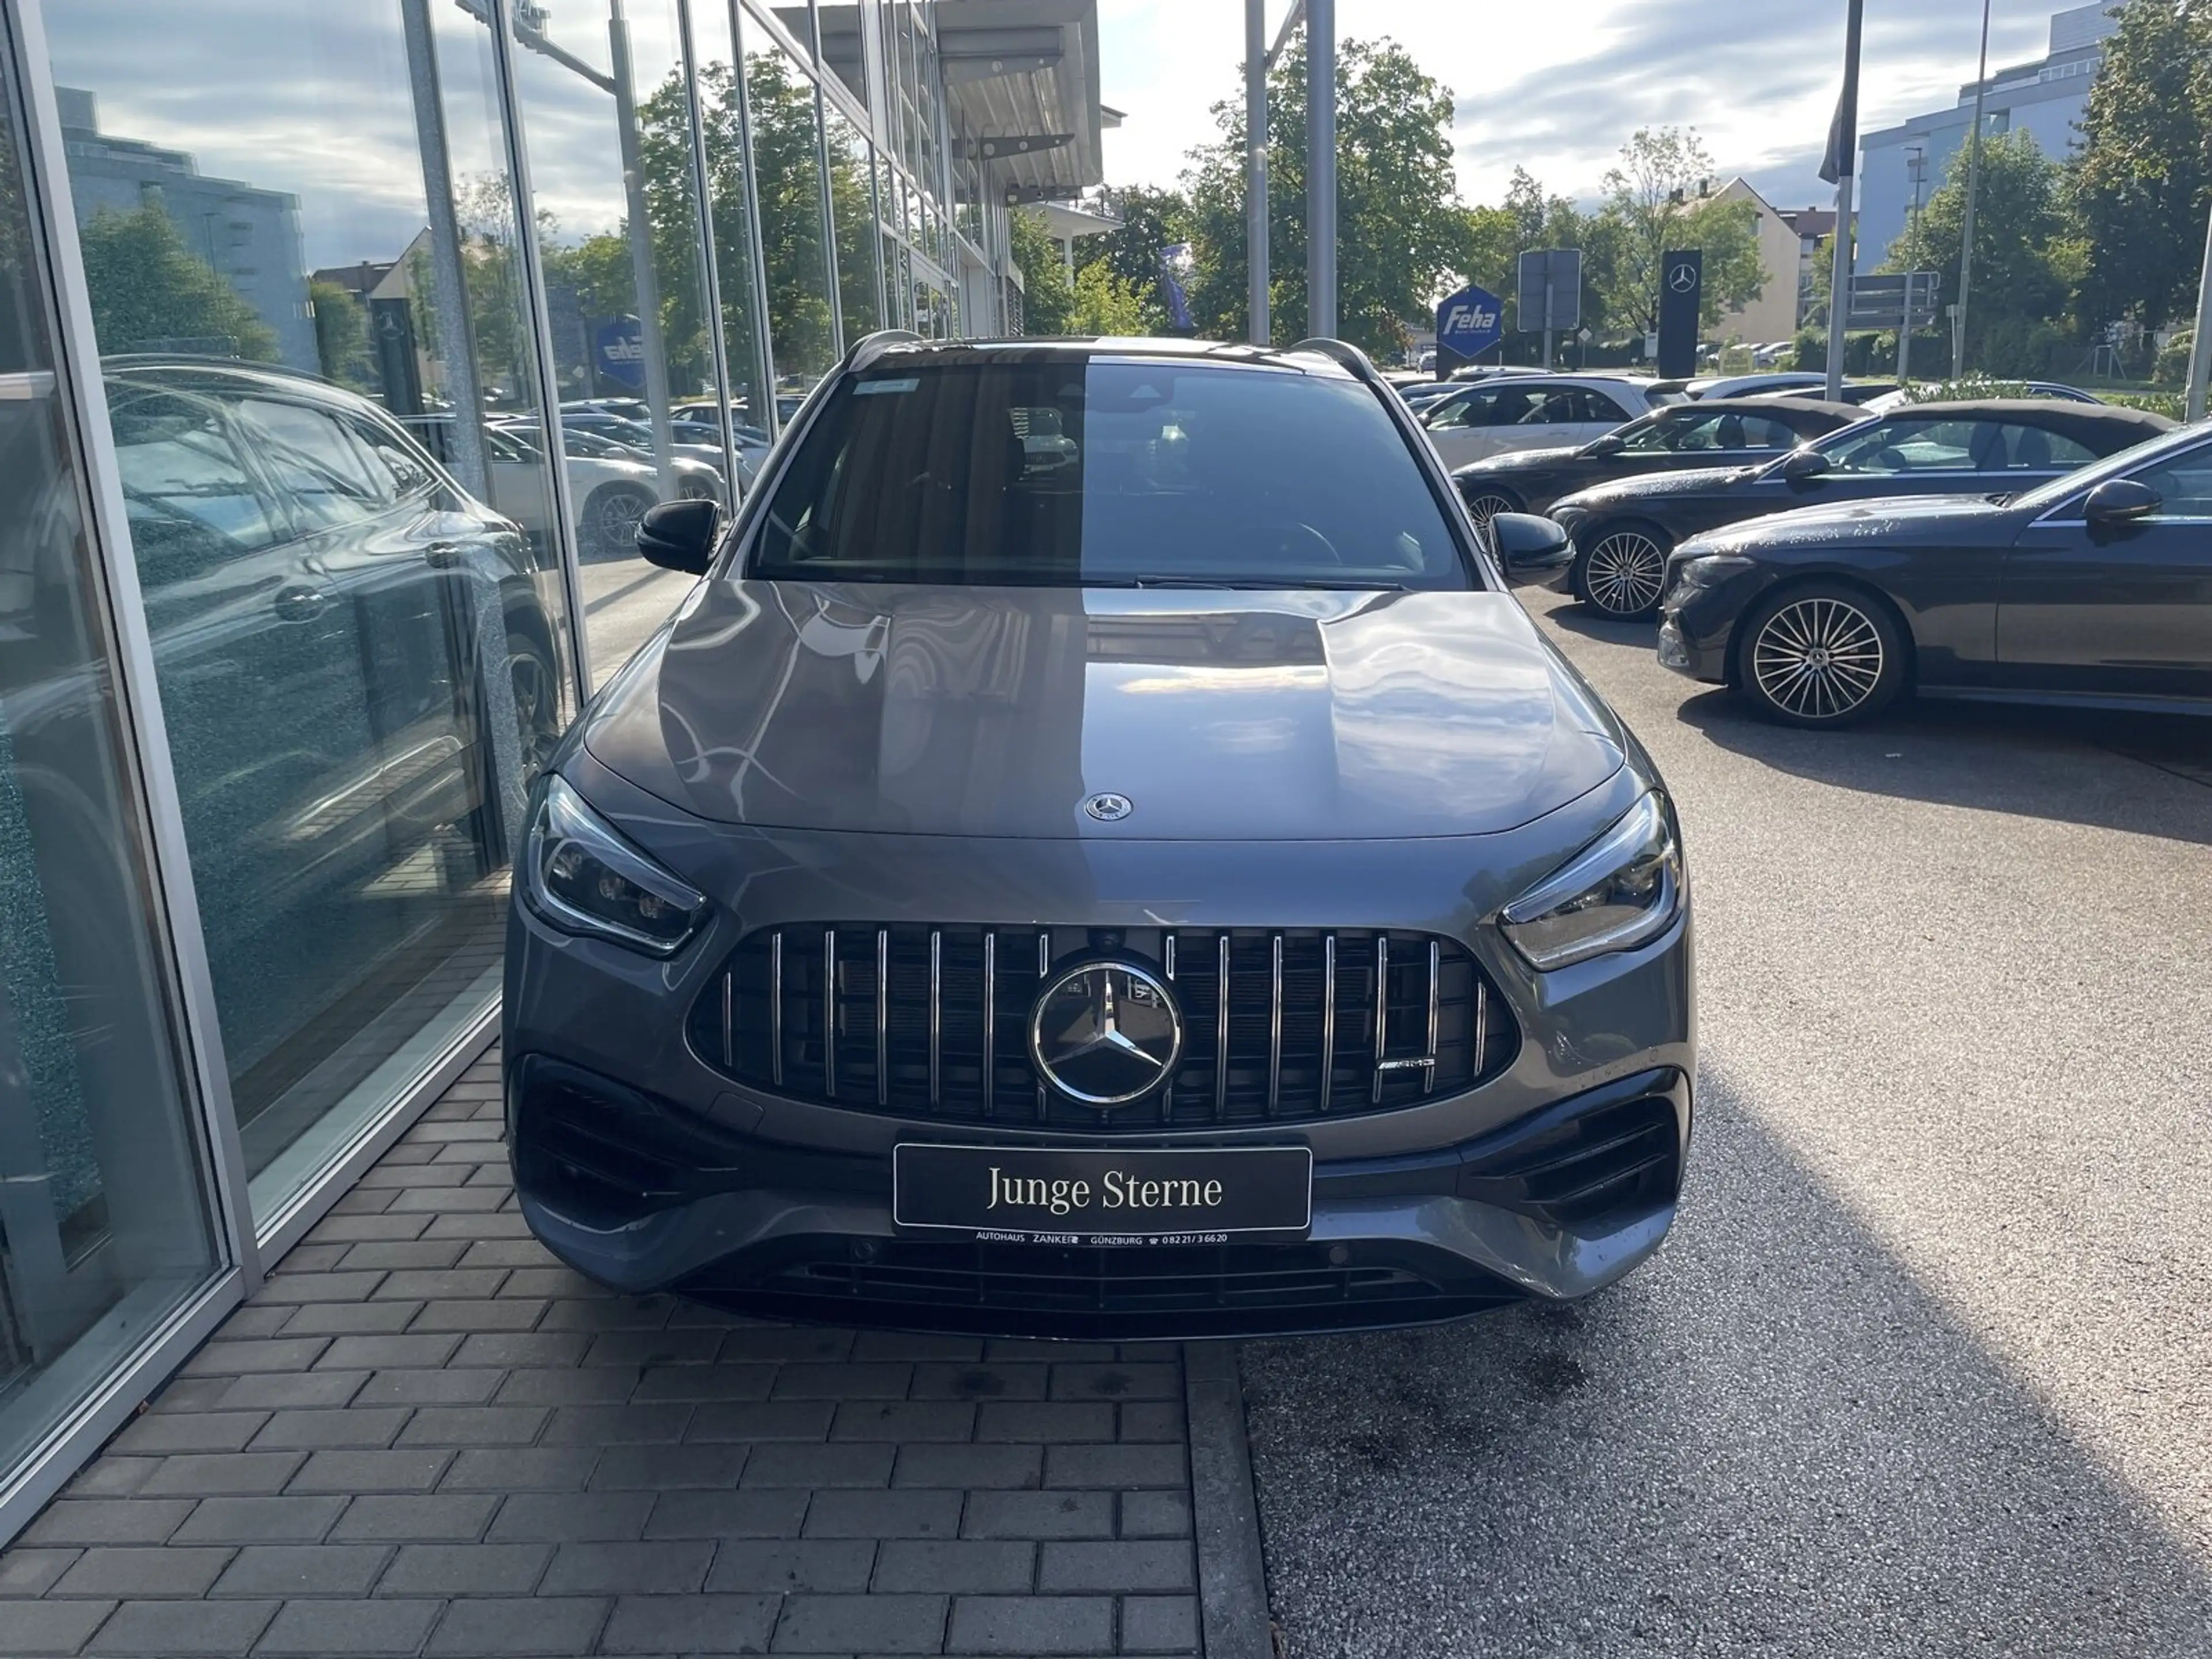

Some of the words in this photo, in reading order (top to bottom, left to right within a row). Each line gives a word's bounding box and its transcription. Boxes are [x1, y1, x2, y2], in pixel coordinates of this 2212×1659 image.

[986, 1166, 1090, 1215] Junge
[1103, 1171, 1222, 1208] Sterne
[976, 1231, 1025, 1242] AUTOHAUS
[1090, 1234, 1143, 1245] GÜNZBURG
